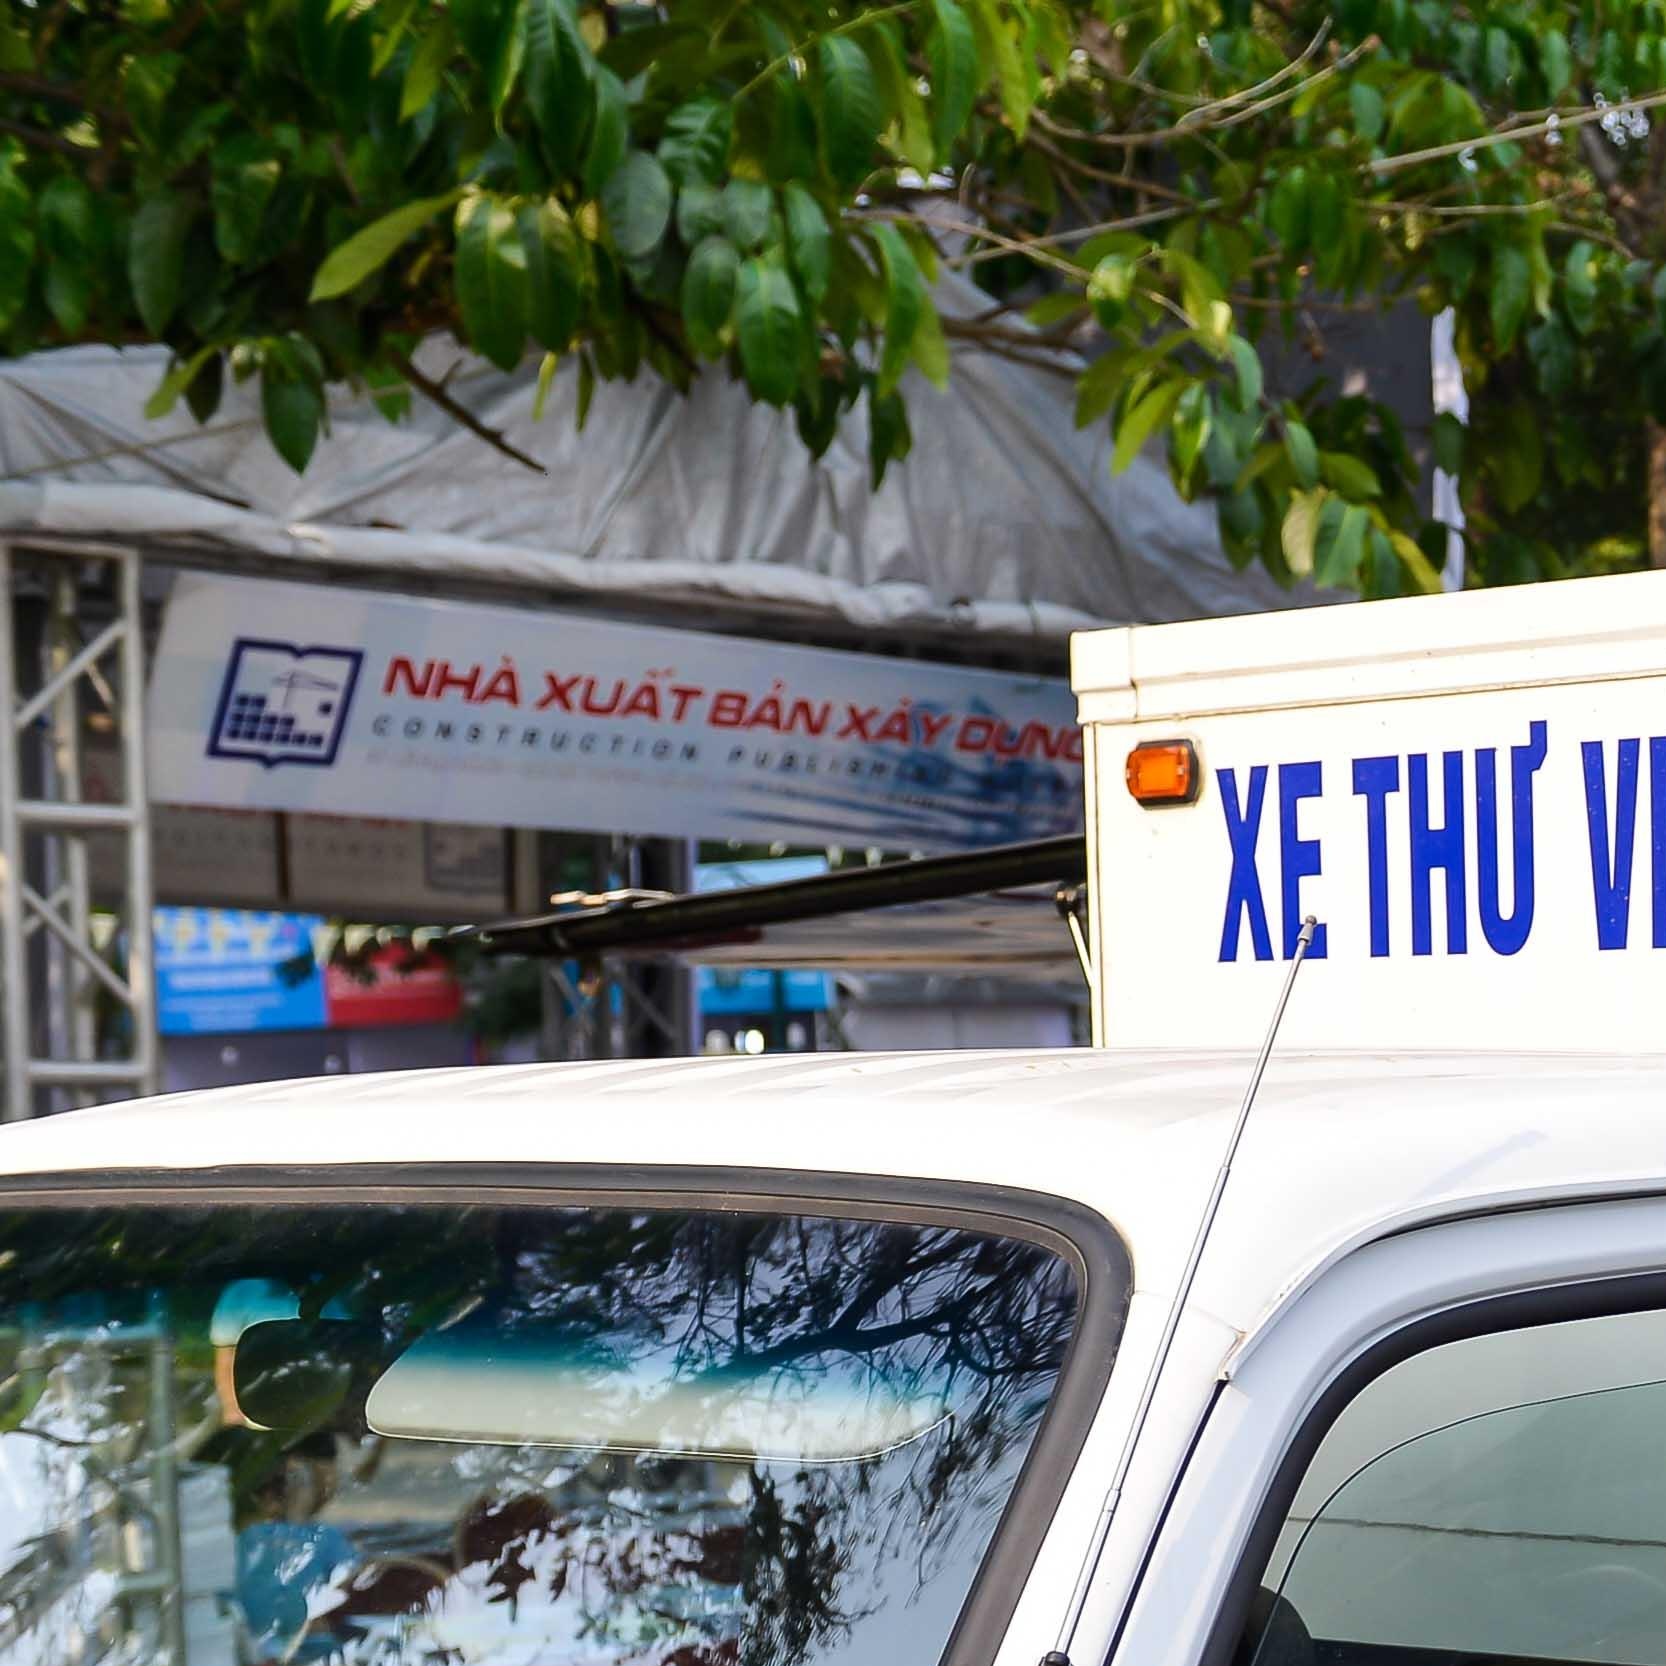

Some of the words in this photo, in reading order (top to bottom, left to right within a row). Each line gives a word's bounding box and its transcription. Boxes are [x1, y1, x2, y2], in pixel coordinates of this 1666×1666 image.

[535, 667, 703, 724] XUẤT
[371, 714, 698, 763] CONSTRUCTION
[1216, 761, 1328, 962] XE
[1352, 720, 1547, 957] THƯ
